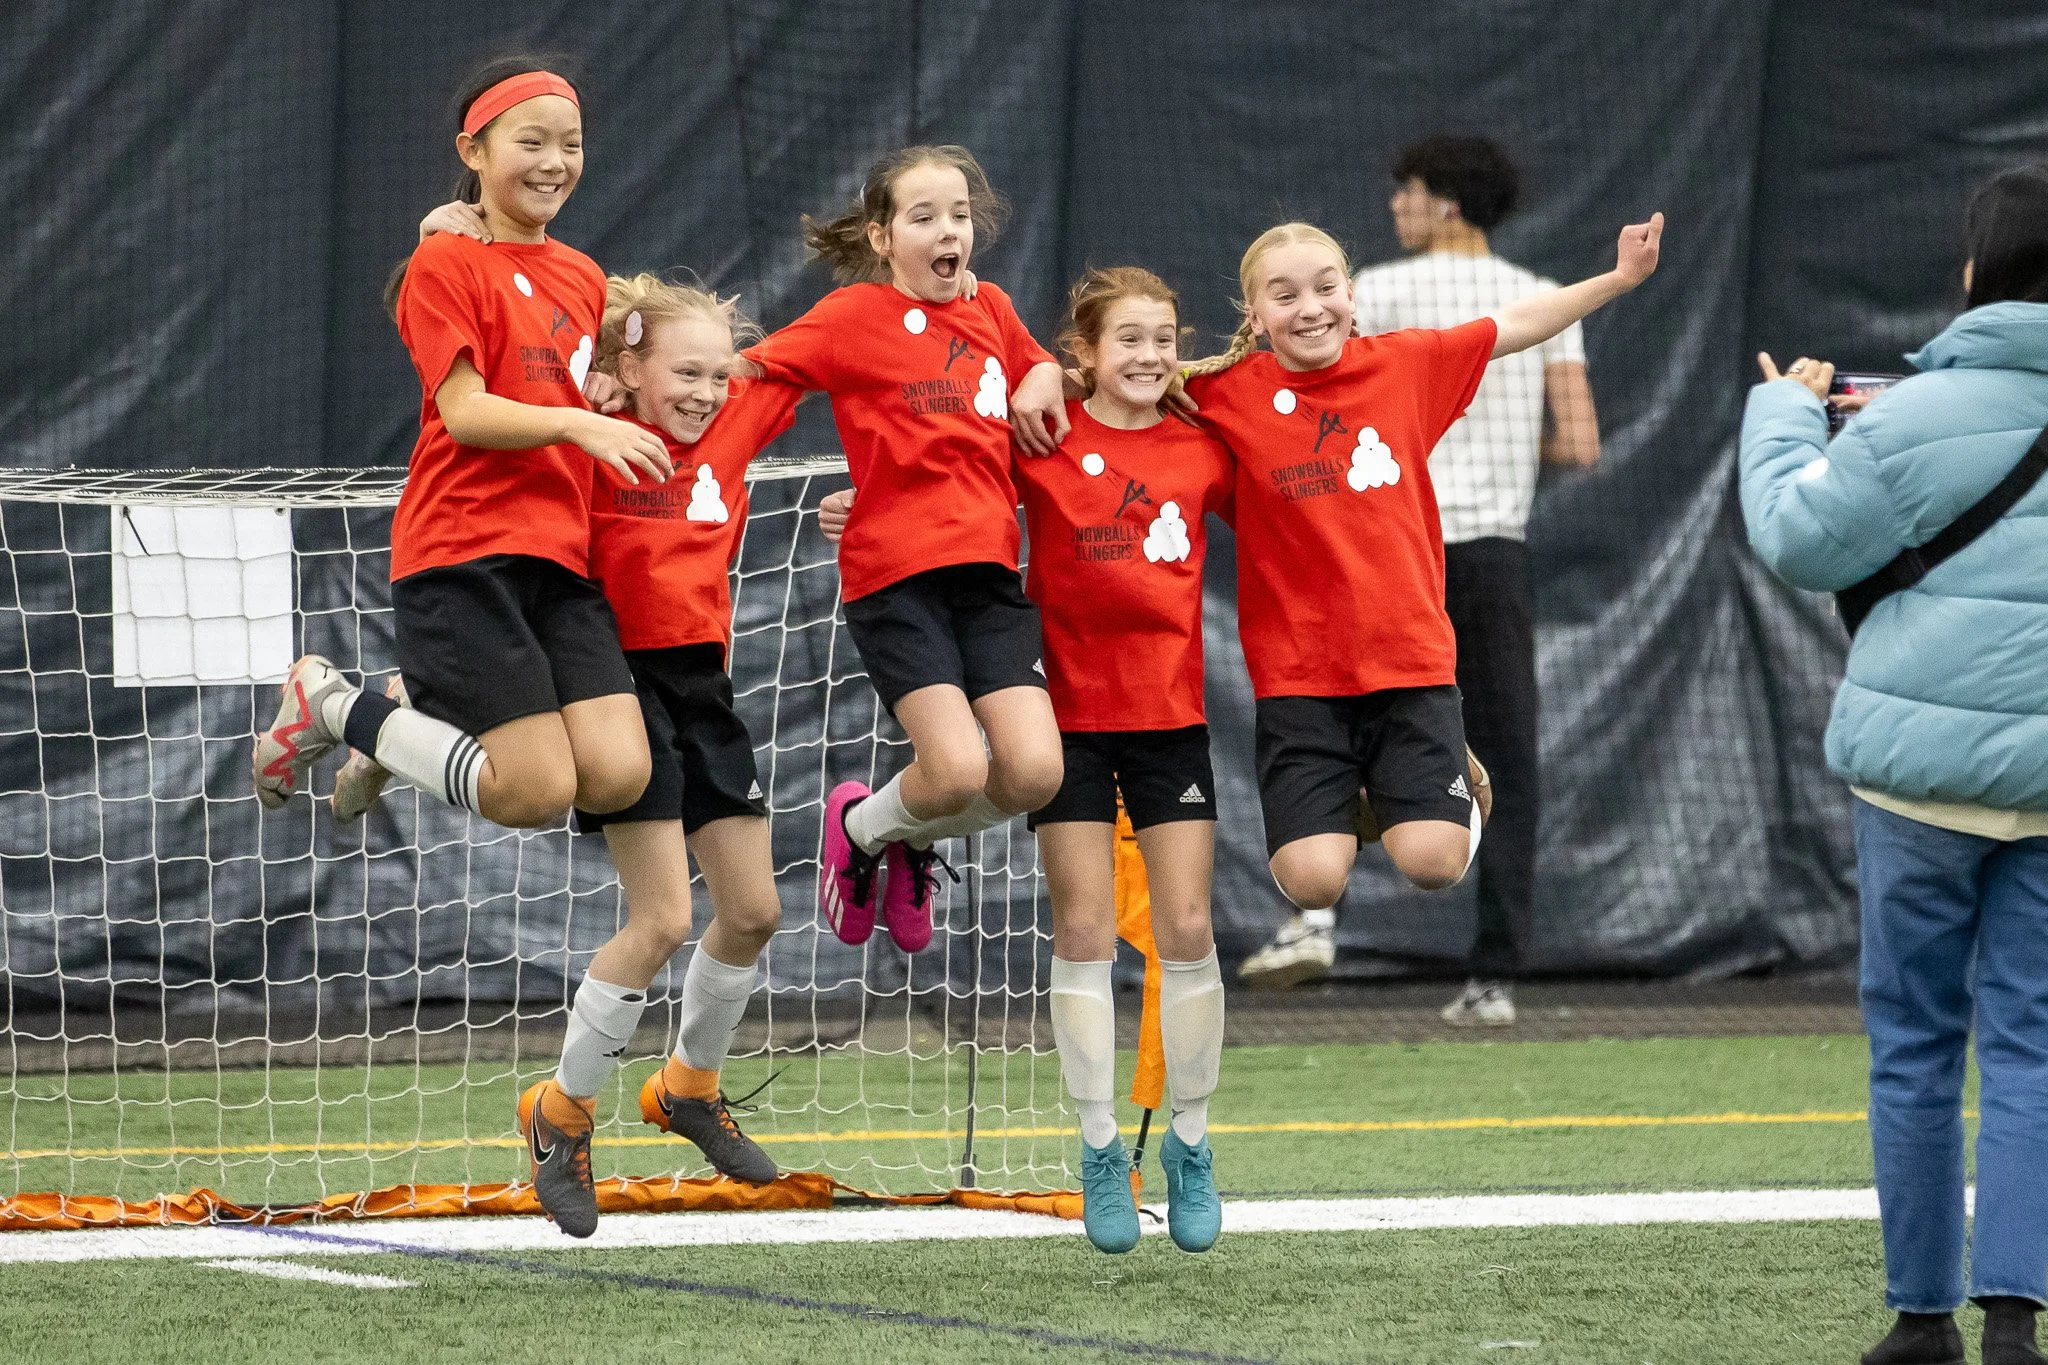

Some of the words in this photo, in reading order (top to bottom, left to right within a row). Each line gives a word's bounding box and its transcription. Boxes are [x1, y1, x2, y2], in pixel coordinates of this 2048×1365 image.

[901, 379, 972, 400] SNOWBALLS
[910, 396, 968, 416] SLINGERS
[1271, 458, 1345, 486] SNOWBALLS
[614, 489, 683, 508] SNOWBALLS
[1280, 477, 1339, 502] SLINGERS
[1075, 544, 1133, 561] SLINGERS
[1179, 795, 1206, 803] adidas
